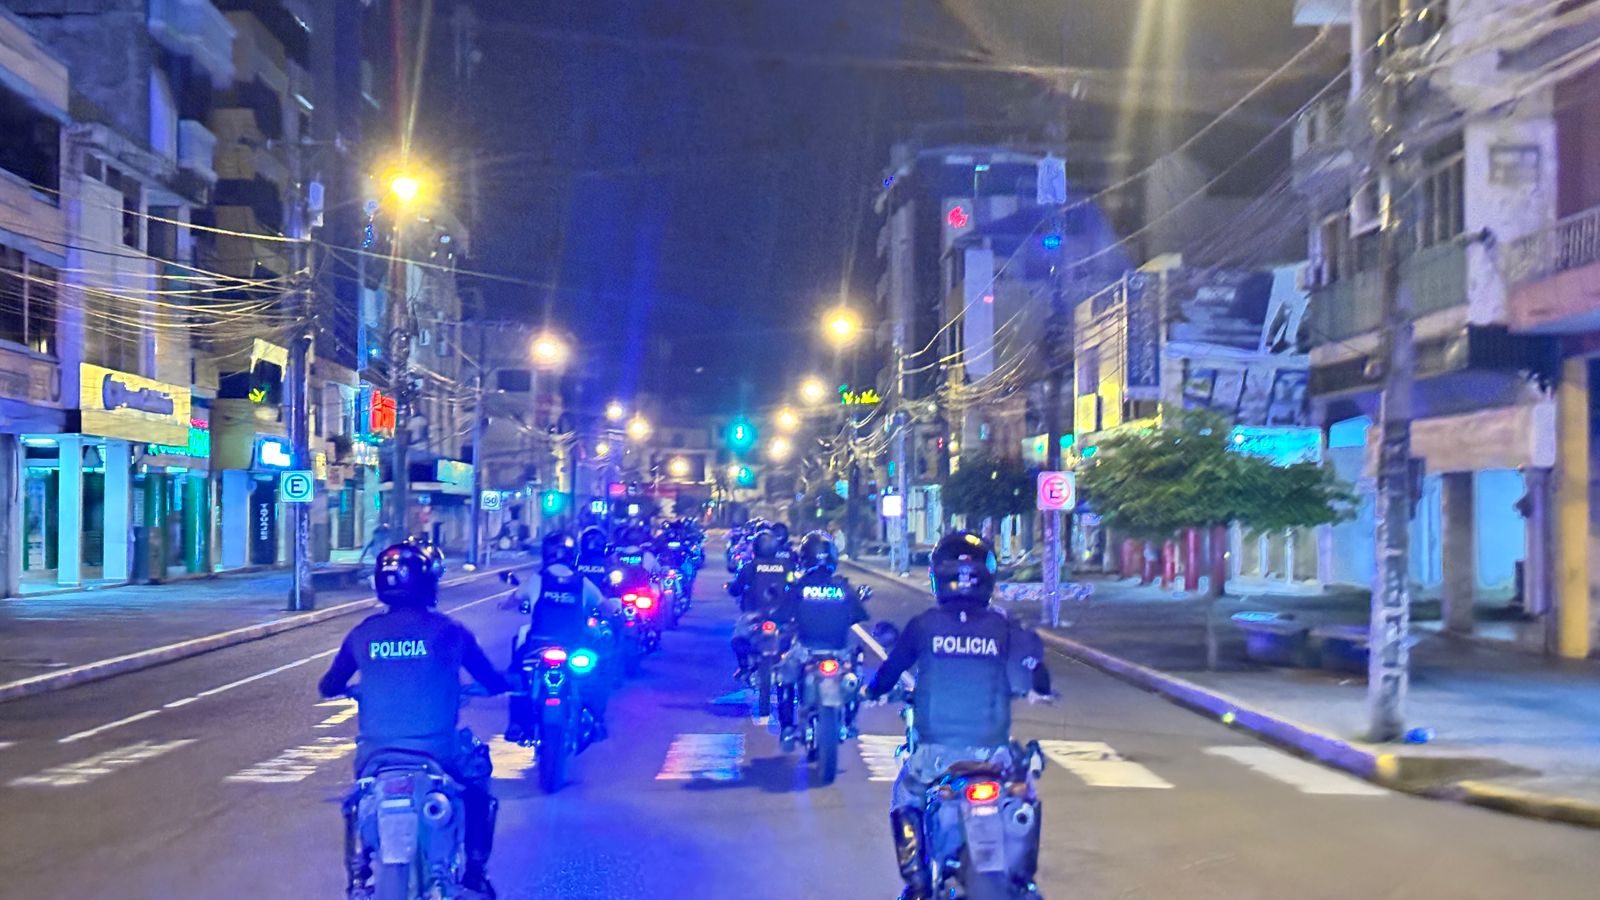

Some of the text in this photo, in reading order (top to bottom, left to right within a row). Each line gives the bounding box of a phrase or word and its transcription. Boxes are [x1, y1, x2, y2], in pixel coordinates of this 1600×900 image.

[291, 479, 303, 493] E
[1050, 482, 1063, 498] E
[577, 565, 605, 573] POLICIA
[756, 564, 784, 573] POLICIA
[803, 586, 844, 599] POLICIA
[370, 640, 427, 658] POLICIA
[933, 635, 998, 656] POLICIA
